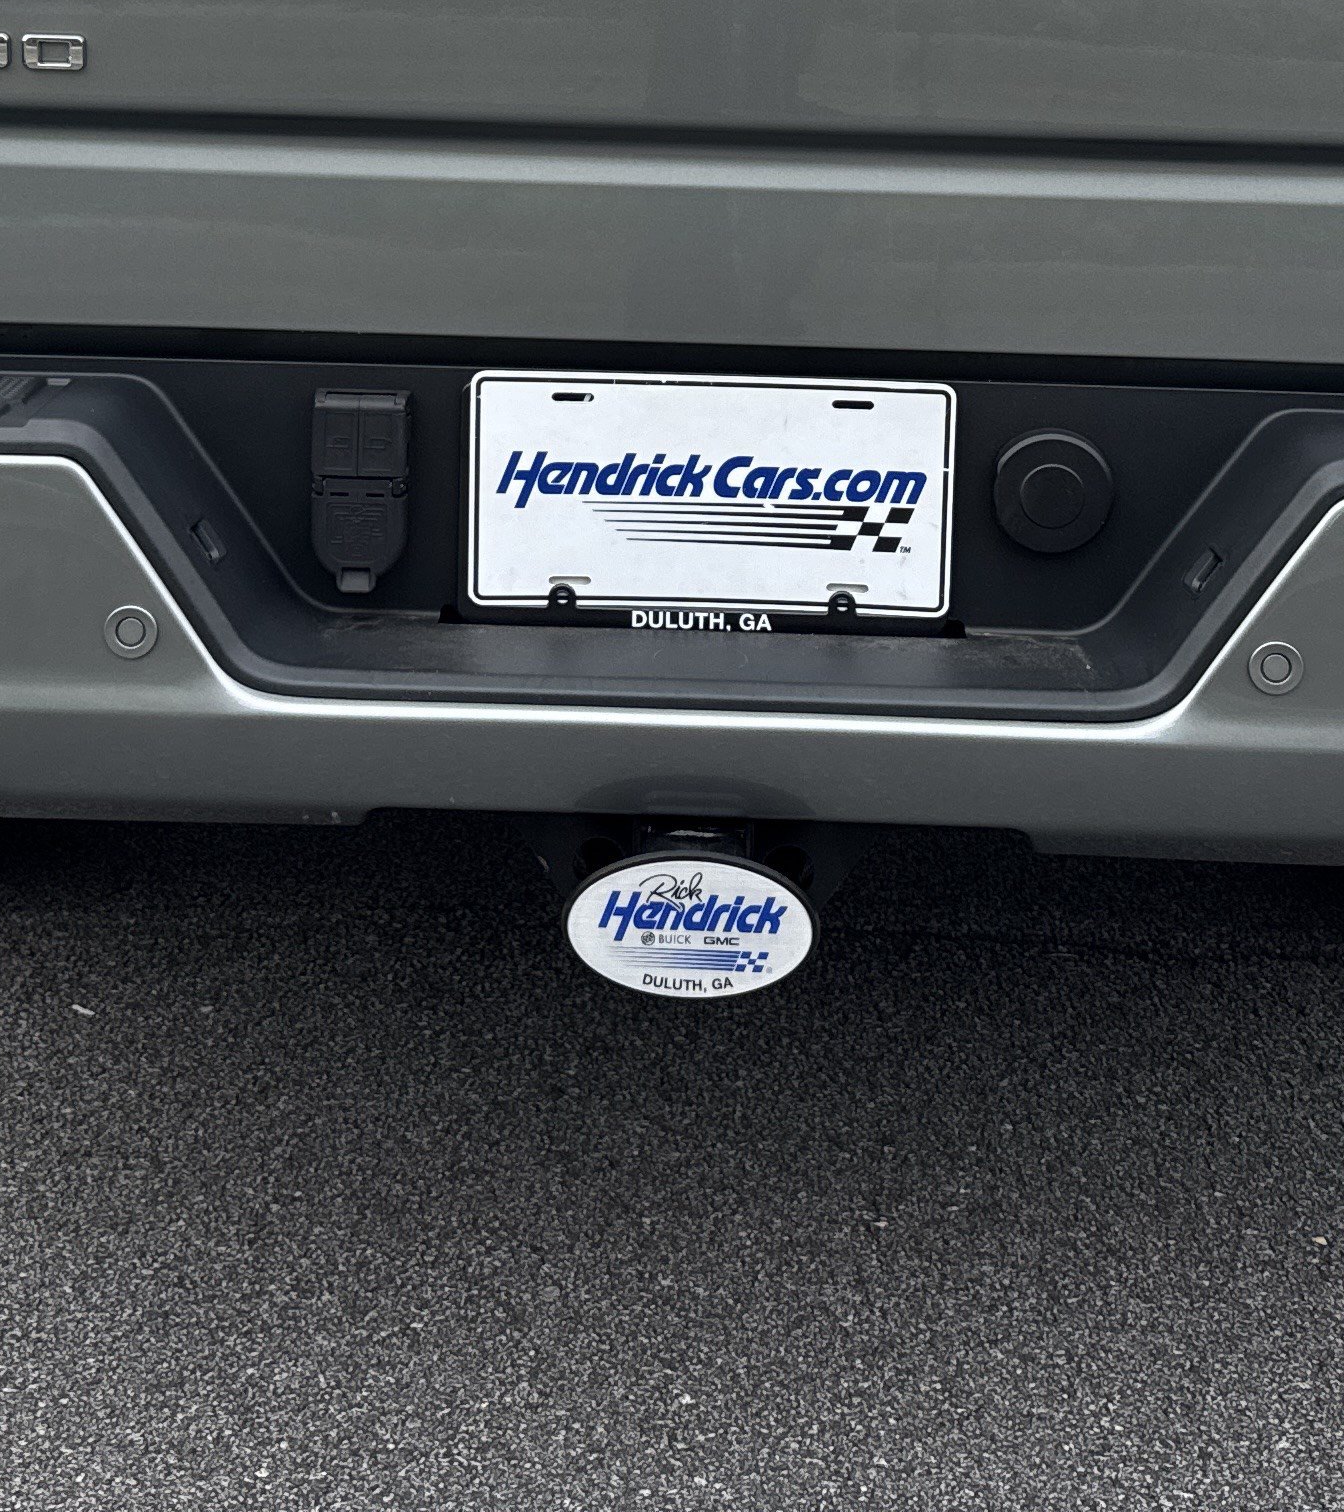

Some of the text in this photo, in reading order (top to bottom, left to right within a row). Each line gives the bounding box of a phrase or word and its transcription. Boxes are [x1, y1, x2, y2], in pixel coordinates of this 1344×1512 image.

[630, 610, 772, 633] DULUTH, GA
[638, 872, 704, 908] Rick
[598, 890, 789, 942] Hendrick
[658, 934, 741, 946] BUICK GMC
[642, 973, 734, 993] DULUTH, GA
